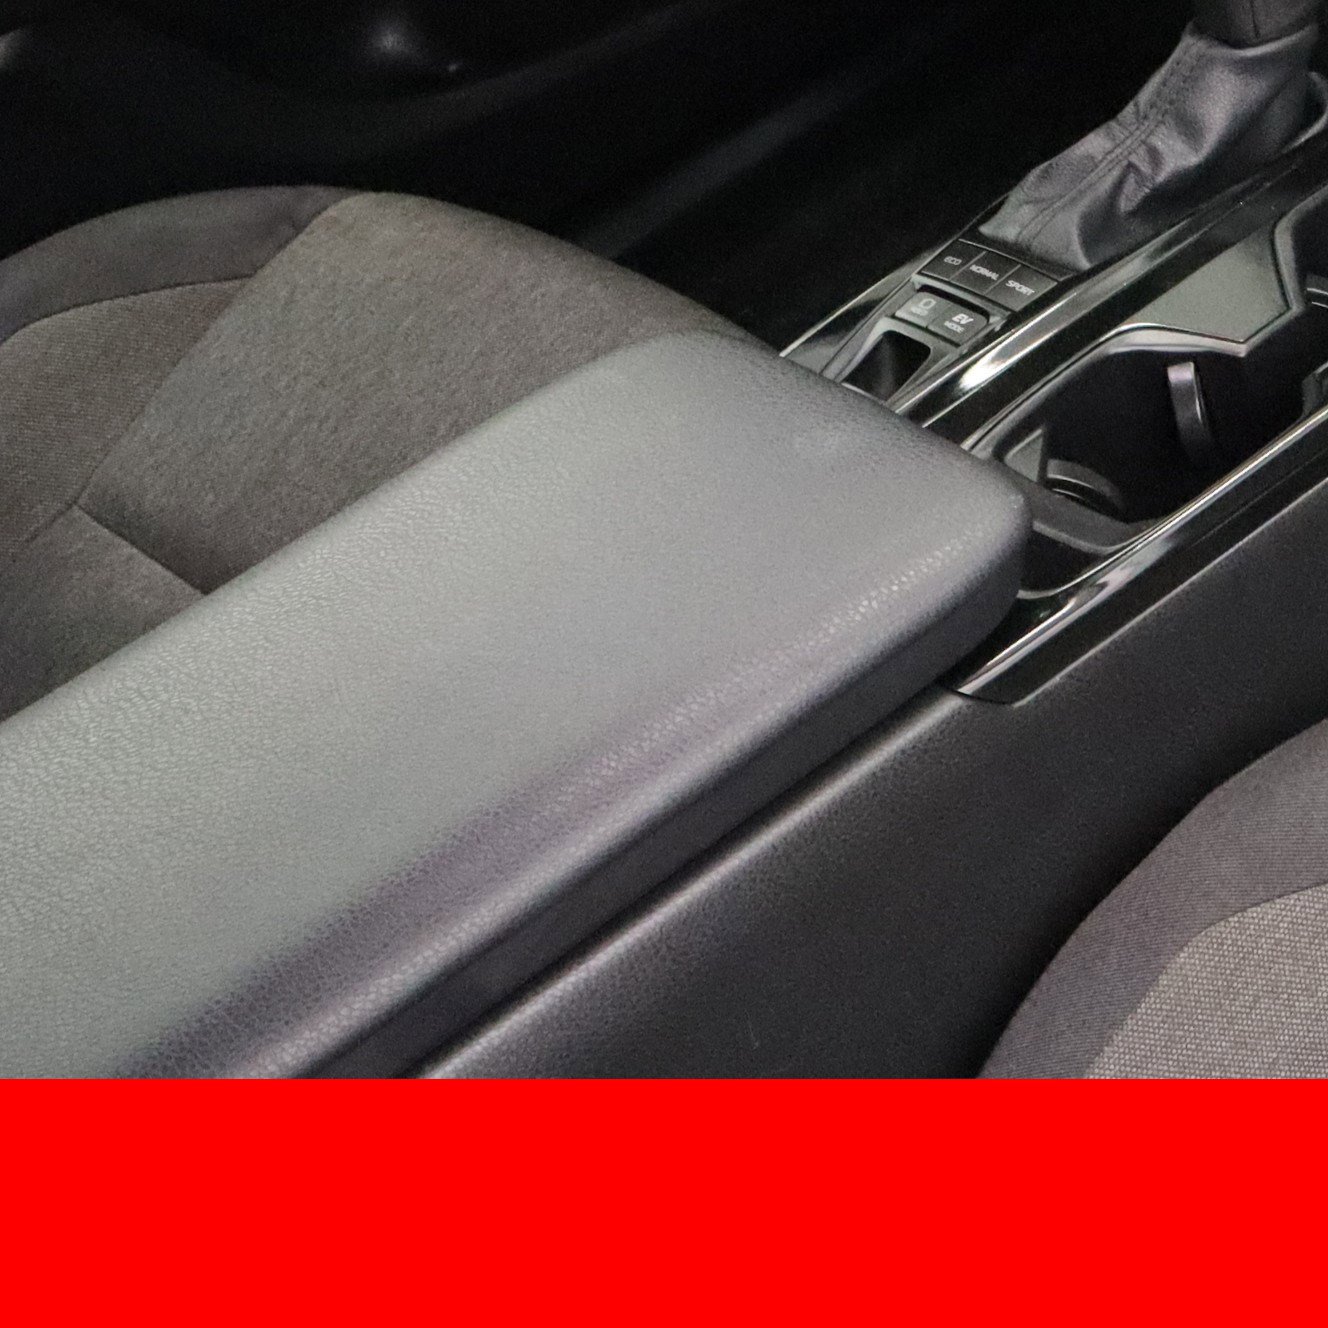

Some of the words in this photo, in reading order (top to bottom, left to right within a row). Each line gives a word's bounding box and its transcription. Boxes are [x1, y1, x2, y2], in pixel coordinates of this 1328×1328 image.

[944, 256, 962, 266] ECO
[969, 264, 999, 281] NORMAL
[1005, 279, 1036, 296] SPORT
[951, 313, 975, 325] EV
